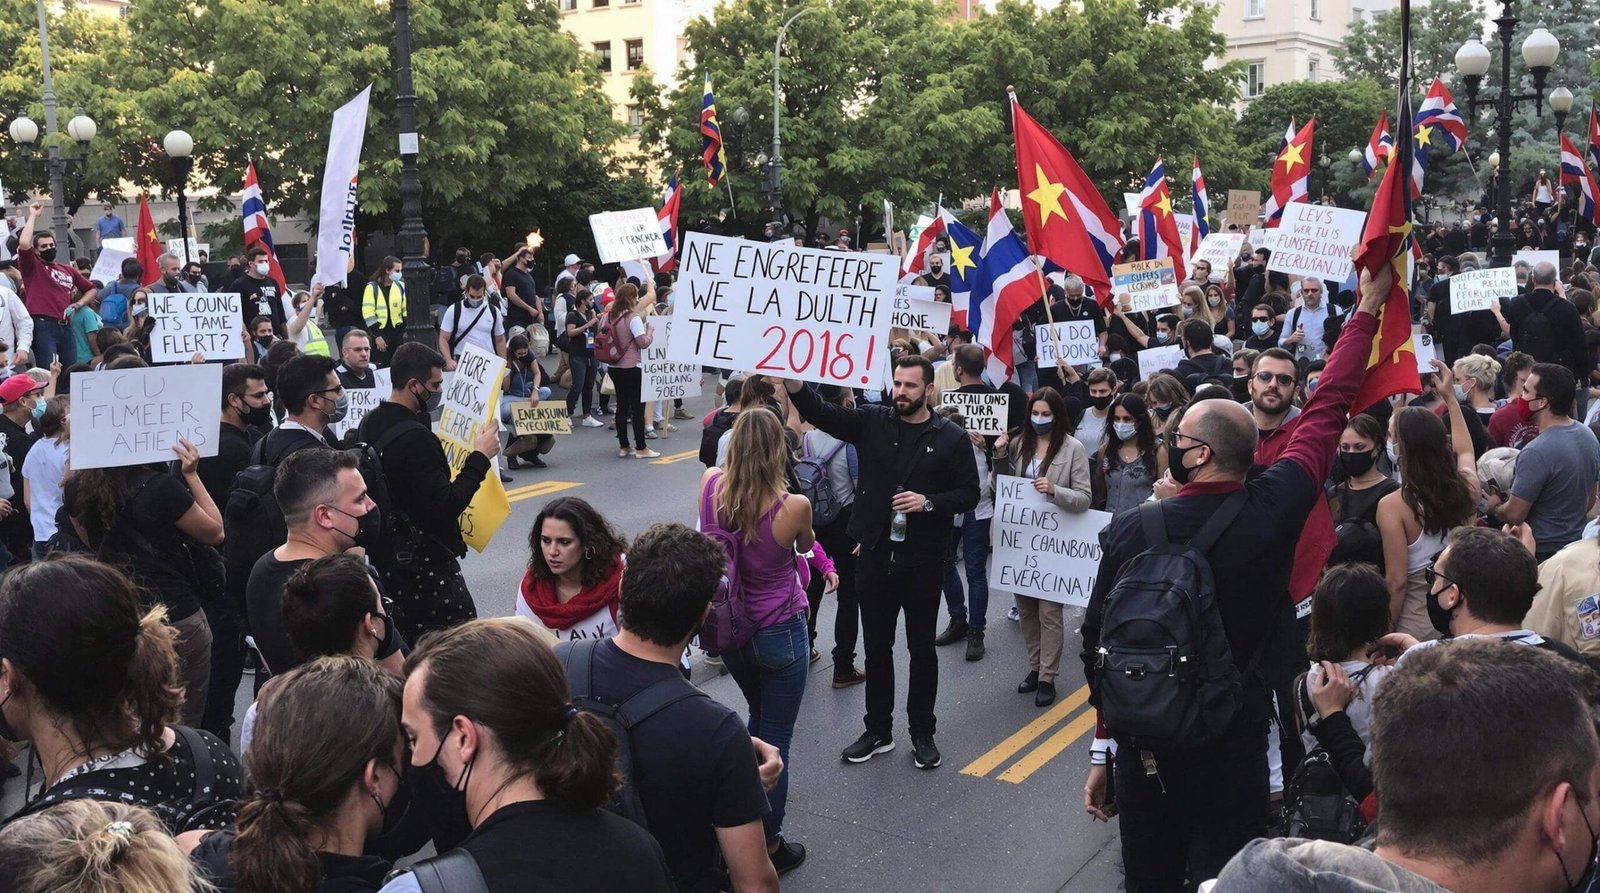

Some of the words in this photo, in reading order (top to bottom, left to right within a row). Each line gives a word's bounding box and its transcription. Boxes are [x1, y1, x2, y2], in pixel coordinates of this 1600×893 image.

[1298, 206, 1334, 225] LEV'S
[686, 240, 724, 275] NE
[734, 246, 882, 292] ENGREFEERE
[153, 296, 178, 314] WE
[691, 280, 730, 312] WE
[747, 286, 782, 317] LA
[795, 290, 877, 328] DULTH
[190, 315, 232, 329] TAME
[891, 311, 934, 330] HONE.
[688, 318, 736, 361] TE
[1069, 325, 1091, 340] DO
[163, 333, 229, 354] FLERT?
[1001, 481, 1025, 500] WE
[1001, 529, 1023, 549] NE
[1024, 554, 1039, 569] IS
